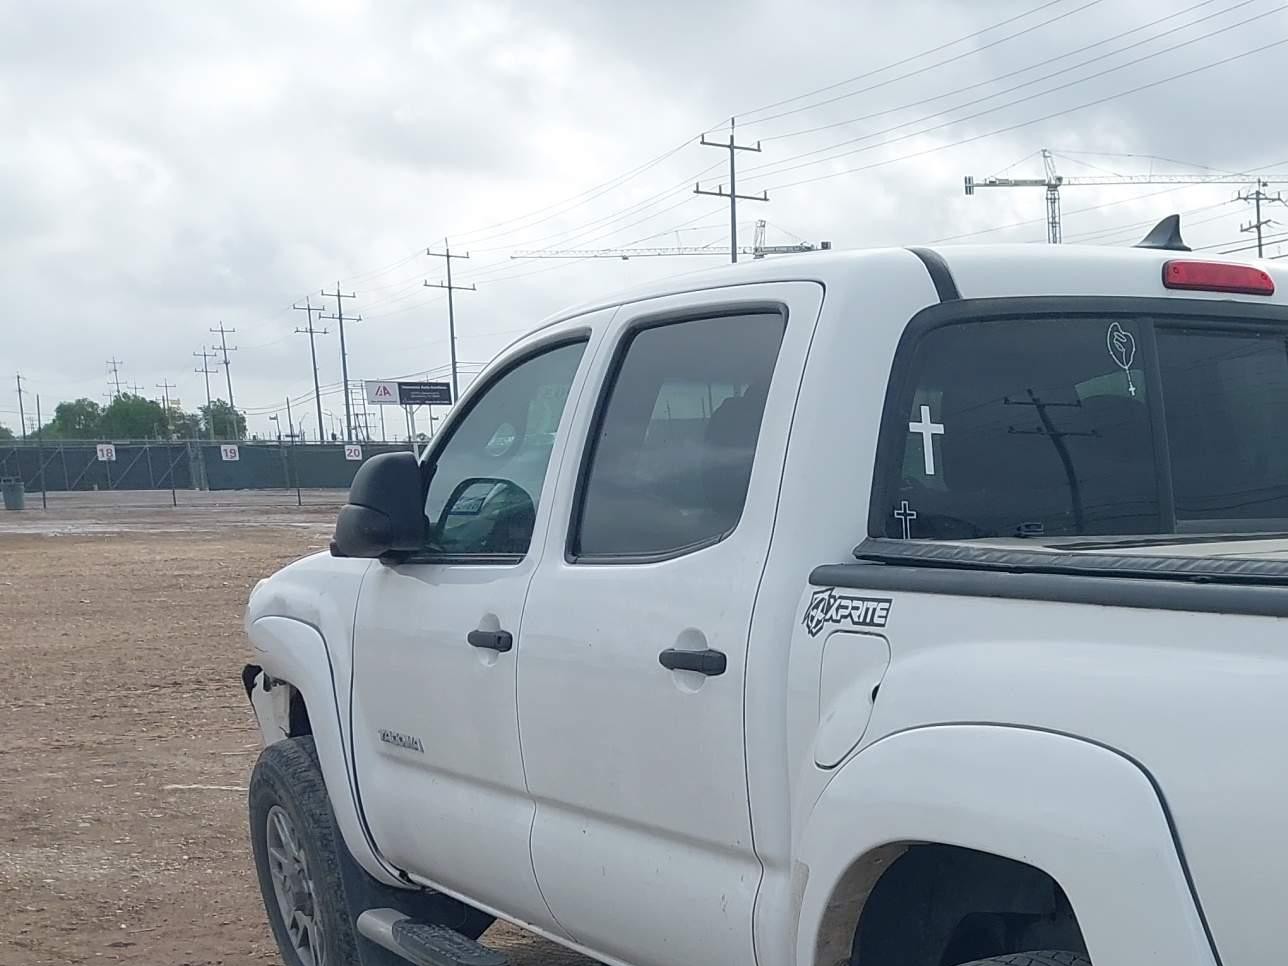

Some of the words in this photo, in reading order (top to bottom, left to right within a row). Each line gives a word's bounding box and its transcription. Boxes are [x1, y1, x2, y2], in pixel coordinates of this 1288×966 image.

[99, 448, 113, 459] 18
[223, 448, 237, 459] 19
[346, 448, 361, 458] 20
